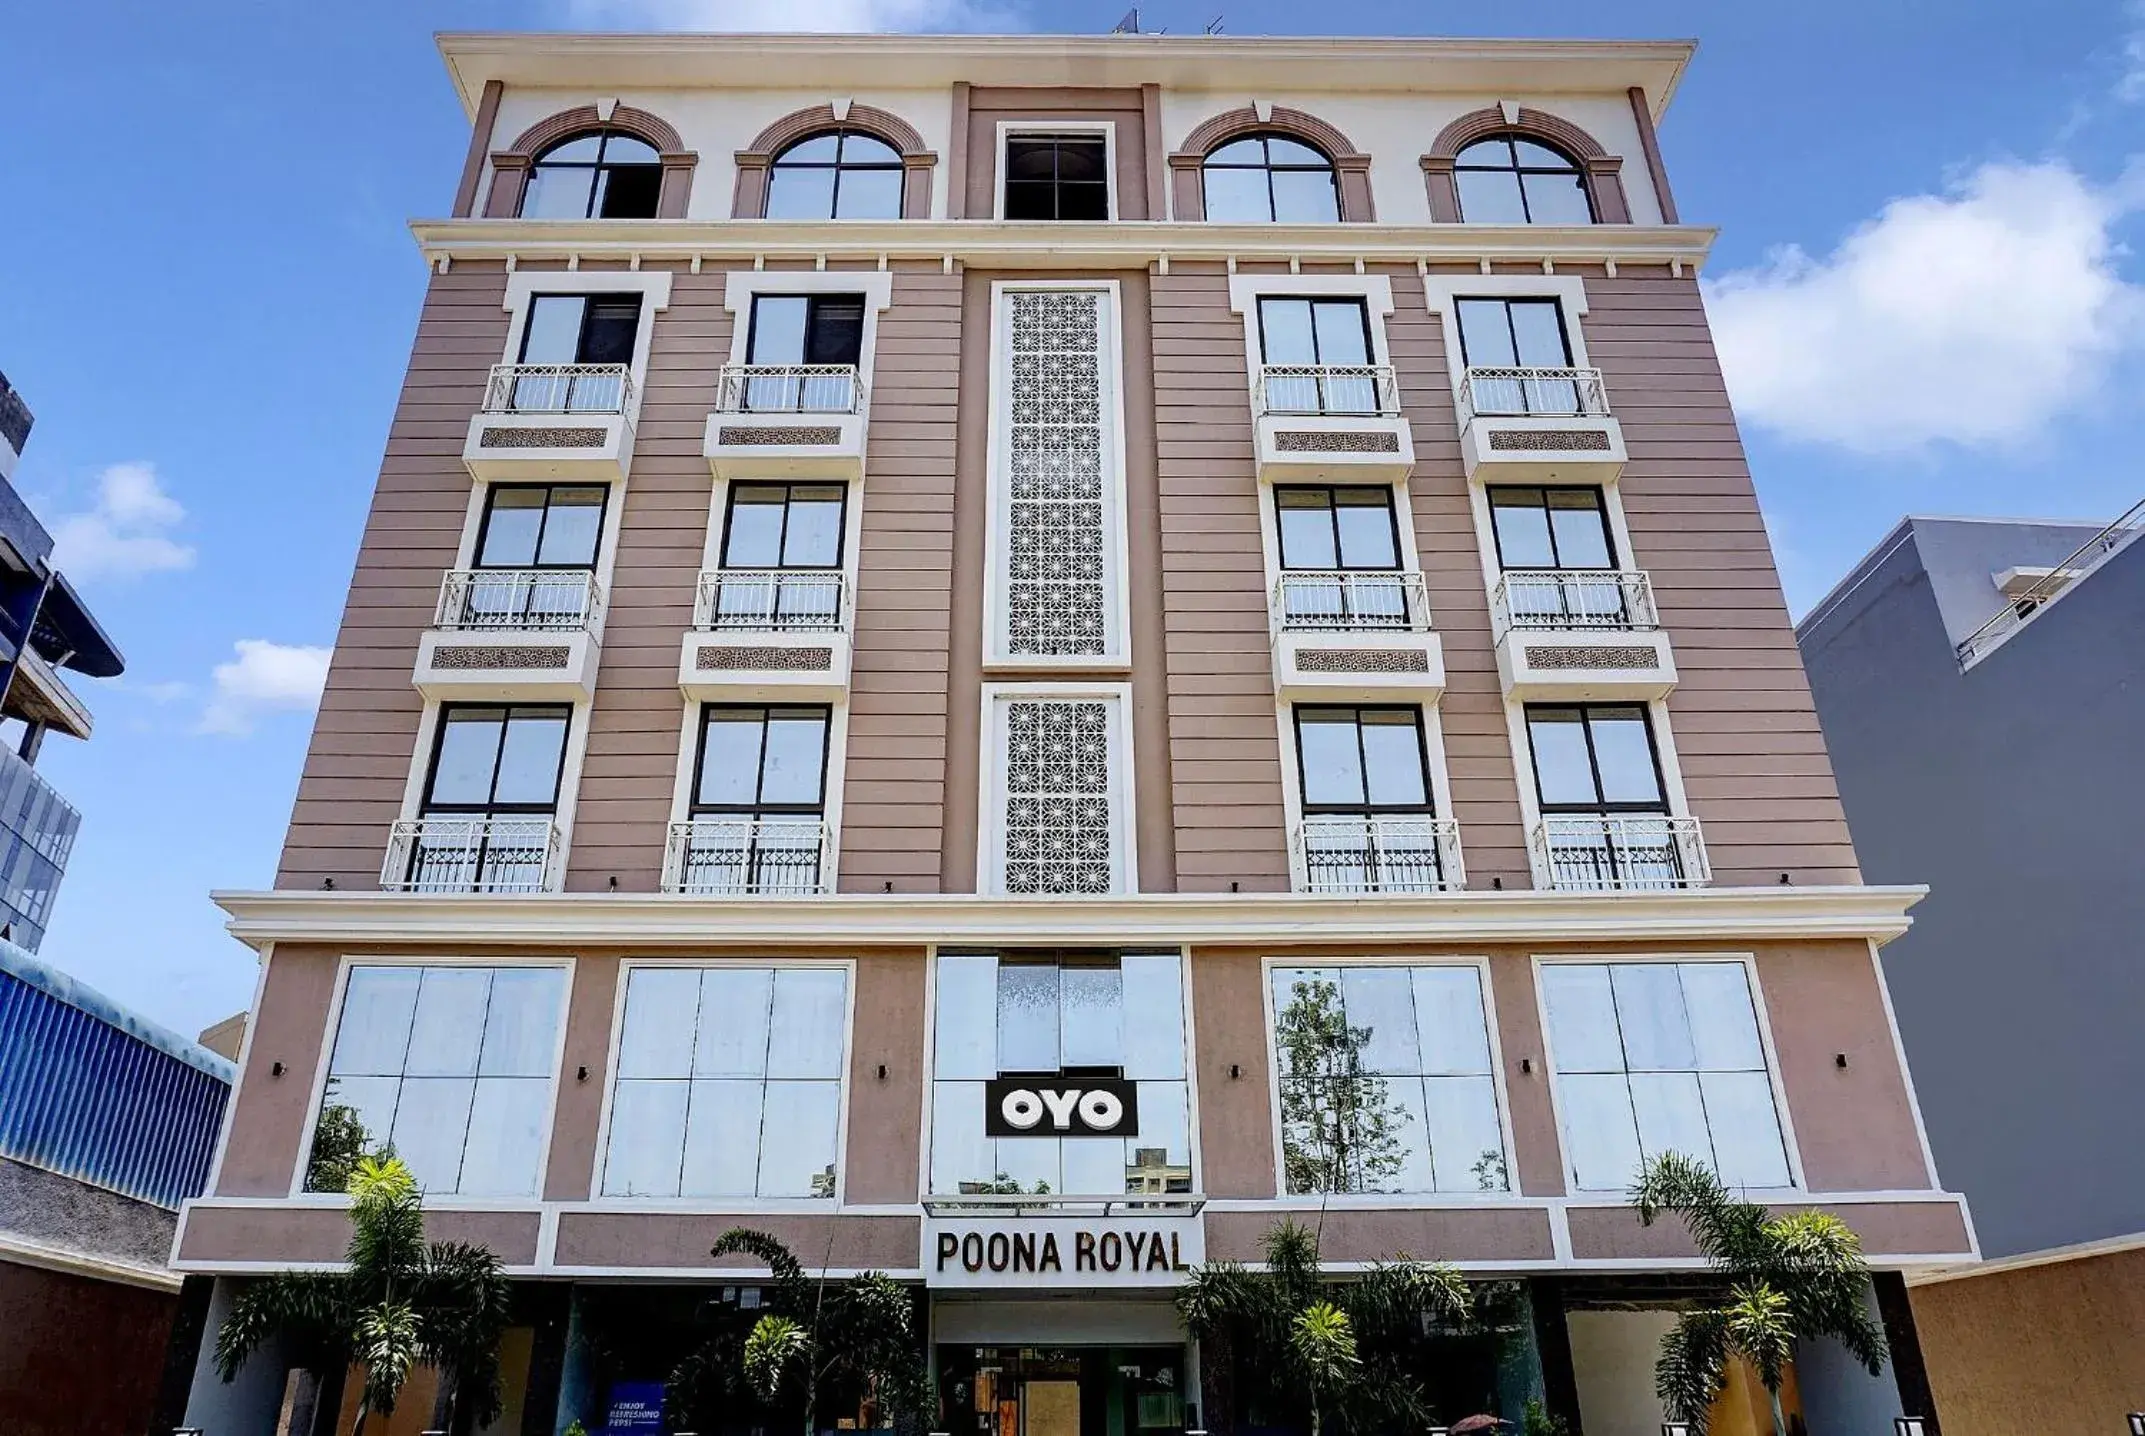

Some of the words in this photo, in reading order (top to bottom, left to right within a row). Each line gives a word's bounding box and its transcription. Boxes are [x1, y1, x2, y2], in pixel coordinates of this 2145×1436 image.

[1002, 1089, 1123, 1130] OYO
[937, 1232, 1062, 1272] POONA
[1076, 1231, 1190, 1271] ROYAL
